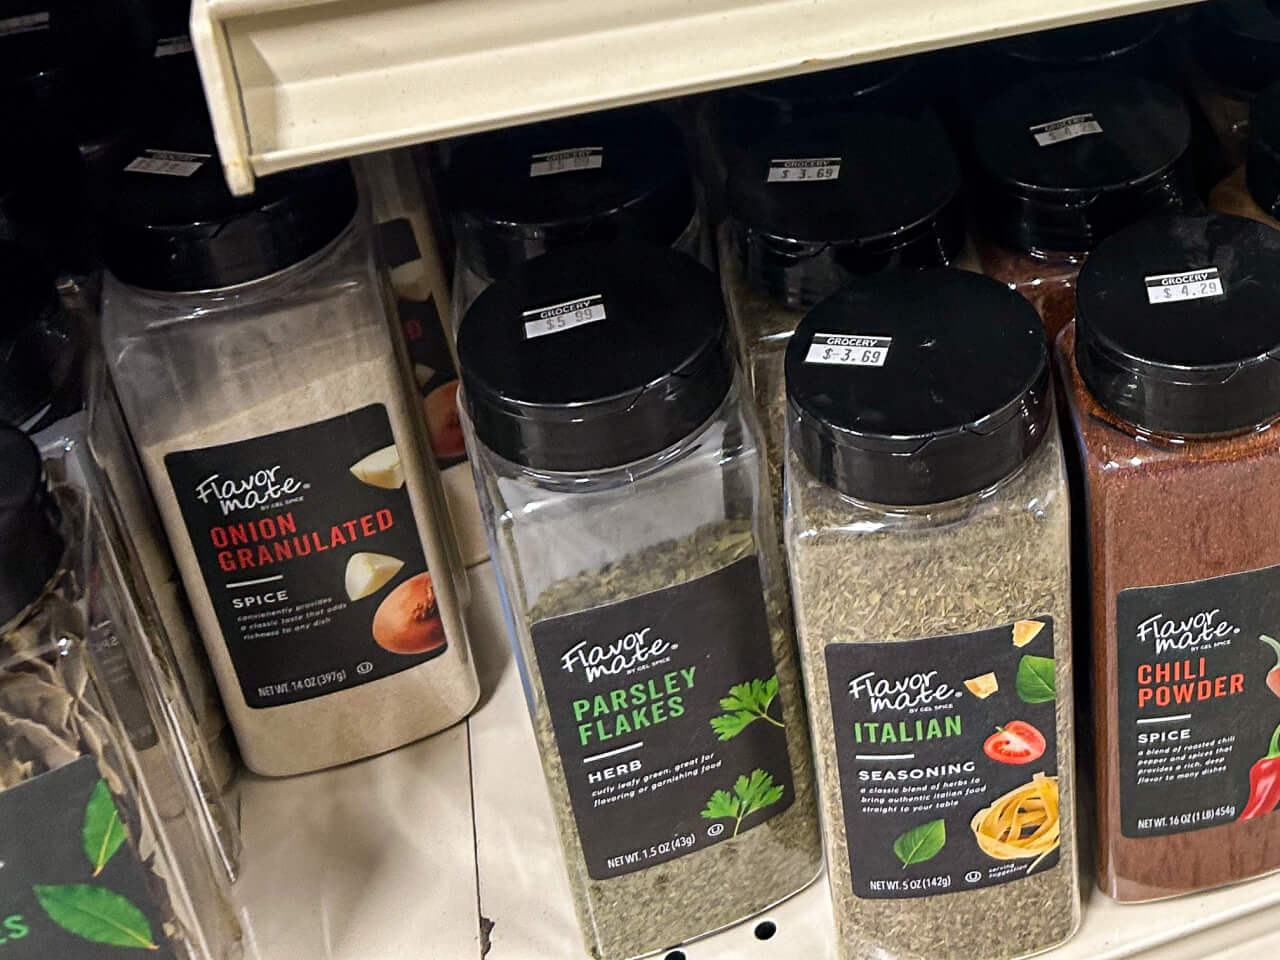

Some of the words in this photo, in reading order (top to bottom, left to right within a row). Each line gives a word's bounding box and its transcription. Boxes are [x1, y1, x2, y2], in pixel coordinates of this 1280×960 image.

[1162, 273, 1208, 285] GROCERY
[540, 301, 590, 319] GROCERY
[827, 337, 877, 346] GROCERY
[196, 466, 280, 504] Flavor
[210, 512, 296, 549] ONION
[218, 508, 394, 572] GRANULATED
[232, 591, 288, 609] SPICE
[1137, 609, 1220, 642] Flavor
[561, 628, 651, 672] Flavor
[1138, 657, 1206, 684] CHILI
[572, 666, 697, 722] PARSLEY
[849, 671, 937, 699] Flavor
[1138, 673, 1244, 708] POWDER
[578, 696, 685, 746] FLAKES
[854, 715, 962, 743] ITALIAN
[1138, 729, 1191, 744] SPICE
[588, 760, 642, 784] HERB
[675, 758, 698, 772] great
[701, 753, 714, 763] for
[858, 762, 976, 781] SEASONING
[594, 790, 635, 807] flavoring
[652, 769, 698, 790] garnishing
[701, 760, 722, 774] food
[861, 796, 885, 804] bring
[888, 795, 930, 803] authentic
[965, 785, 986, 796] food
[869, 786, 899, 794] classic
[903, 785, 927, 793] blend
[943, 778, 968, 788] herbs
[862, 806, 897, 814] straight
[913, 804, 933, 813] your
[936, 800, 959, 808] table
[608, 856, 625, 868] NET
[642, 847, 656, 859] 1.5
[658, 843, 670, 854] OZ
[672, 834, 695, 851] (43g)
[870, 880, 887, 890] NET
[903, 879, 908, 889] 5
[910, 878, 922, 888] OZ
[923, 875, 951, 888] (142g)
